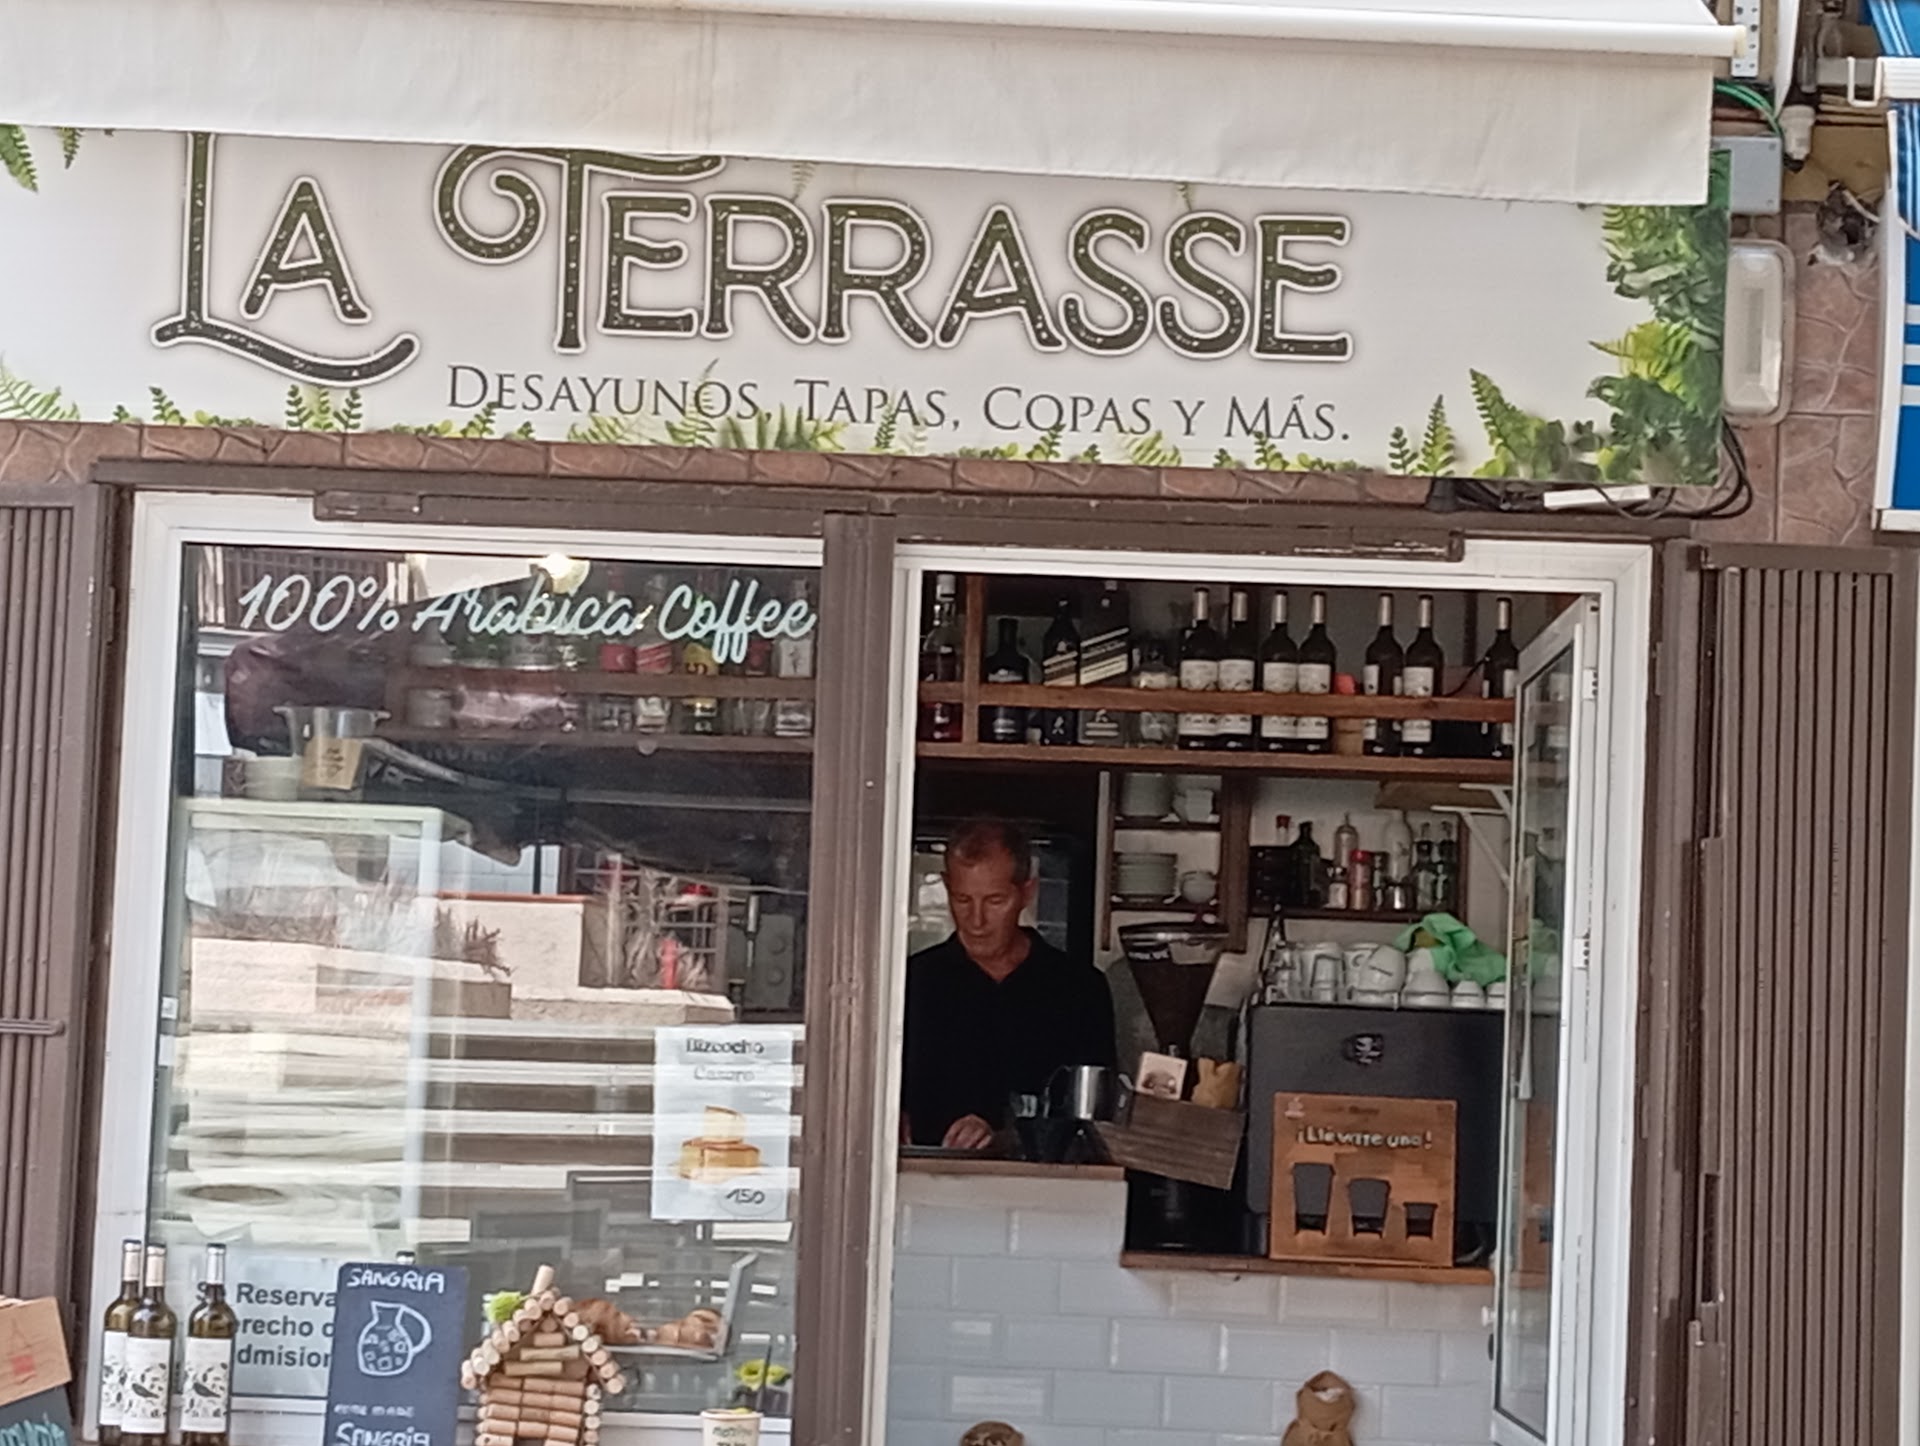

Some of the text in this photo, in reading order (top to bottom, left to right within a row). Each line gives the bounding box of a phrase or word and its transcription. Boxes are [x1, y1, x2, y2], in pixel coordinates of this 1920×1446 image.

[153, 132, 1352, 384] LA TERRASSE
[447, 364, 1351, 441] DESAYUNOS, TAPAS, COPAS Y MÁS.
[238, 572, 819, 664] 100% Arabica Coffee
[236, 1282, 338, 1308] Reserva
[346, 1268, 445, 1295] SANGRIA
[235, 1315, 314, 1337] recho
